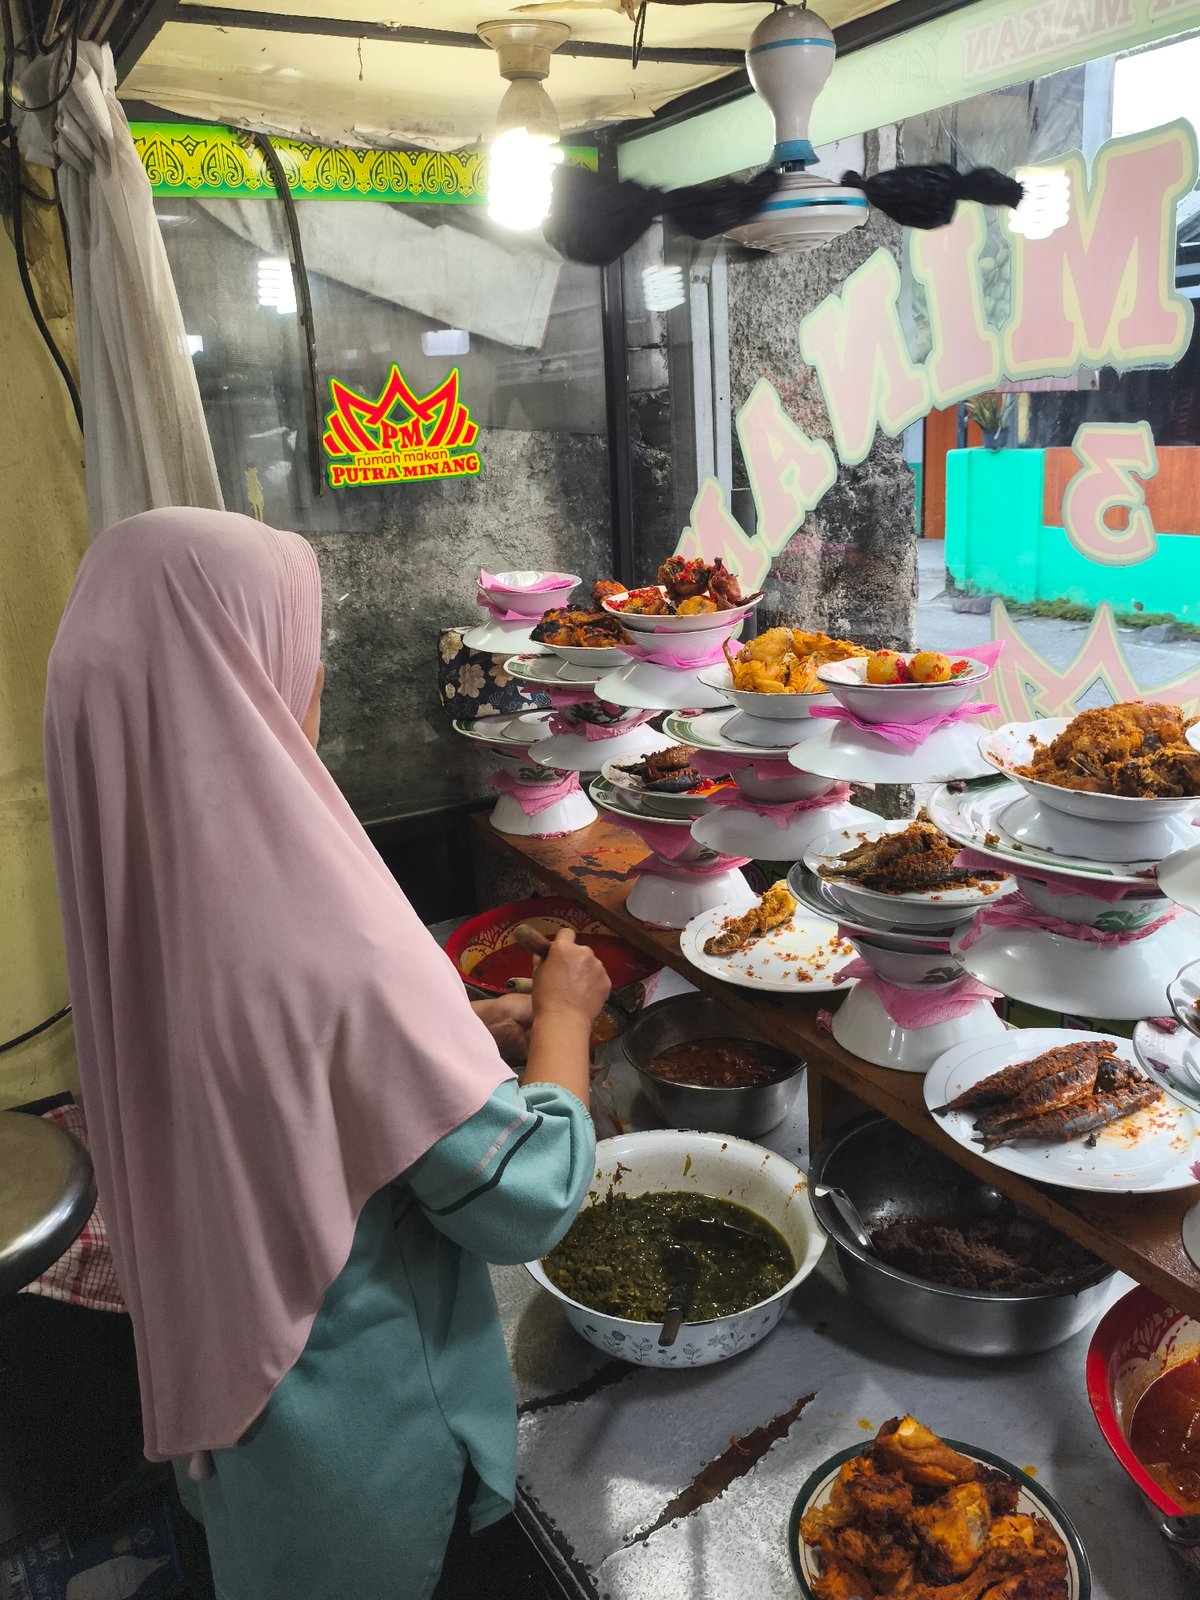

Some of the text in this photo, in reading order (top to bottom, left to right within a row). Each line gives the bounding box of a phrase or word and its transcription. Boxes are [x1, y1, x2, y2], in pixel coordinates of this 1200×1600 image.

[381, 417, 425, 449] PM
[332, 456, 478, 484] PUTRA MINANG
[357, 450, 448, 466] rumah makan
